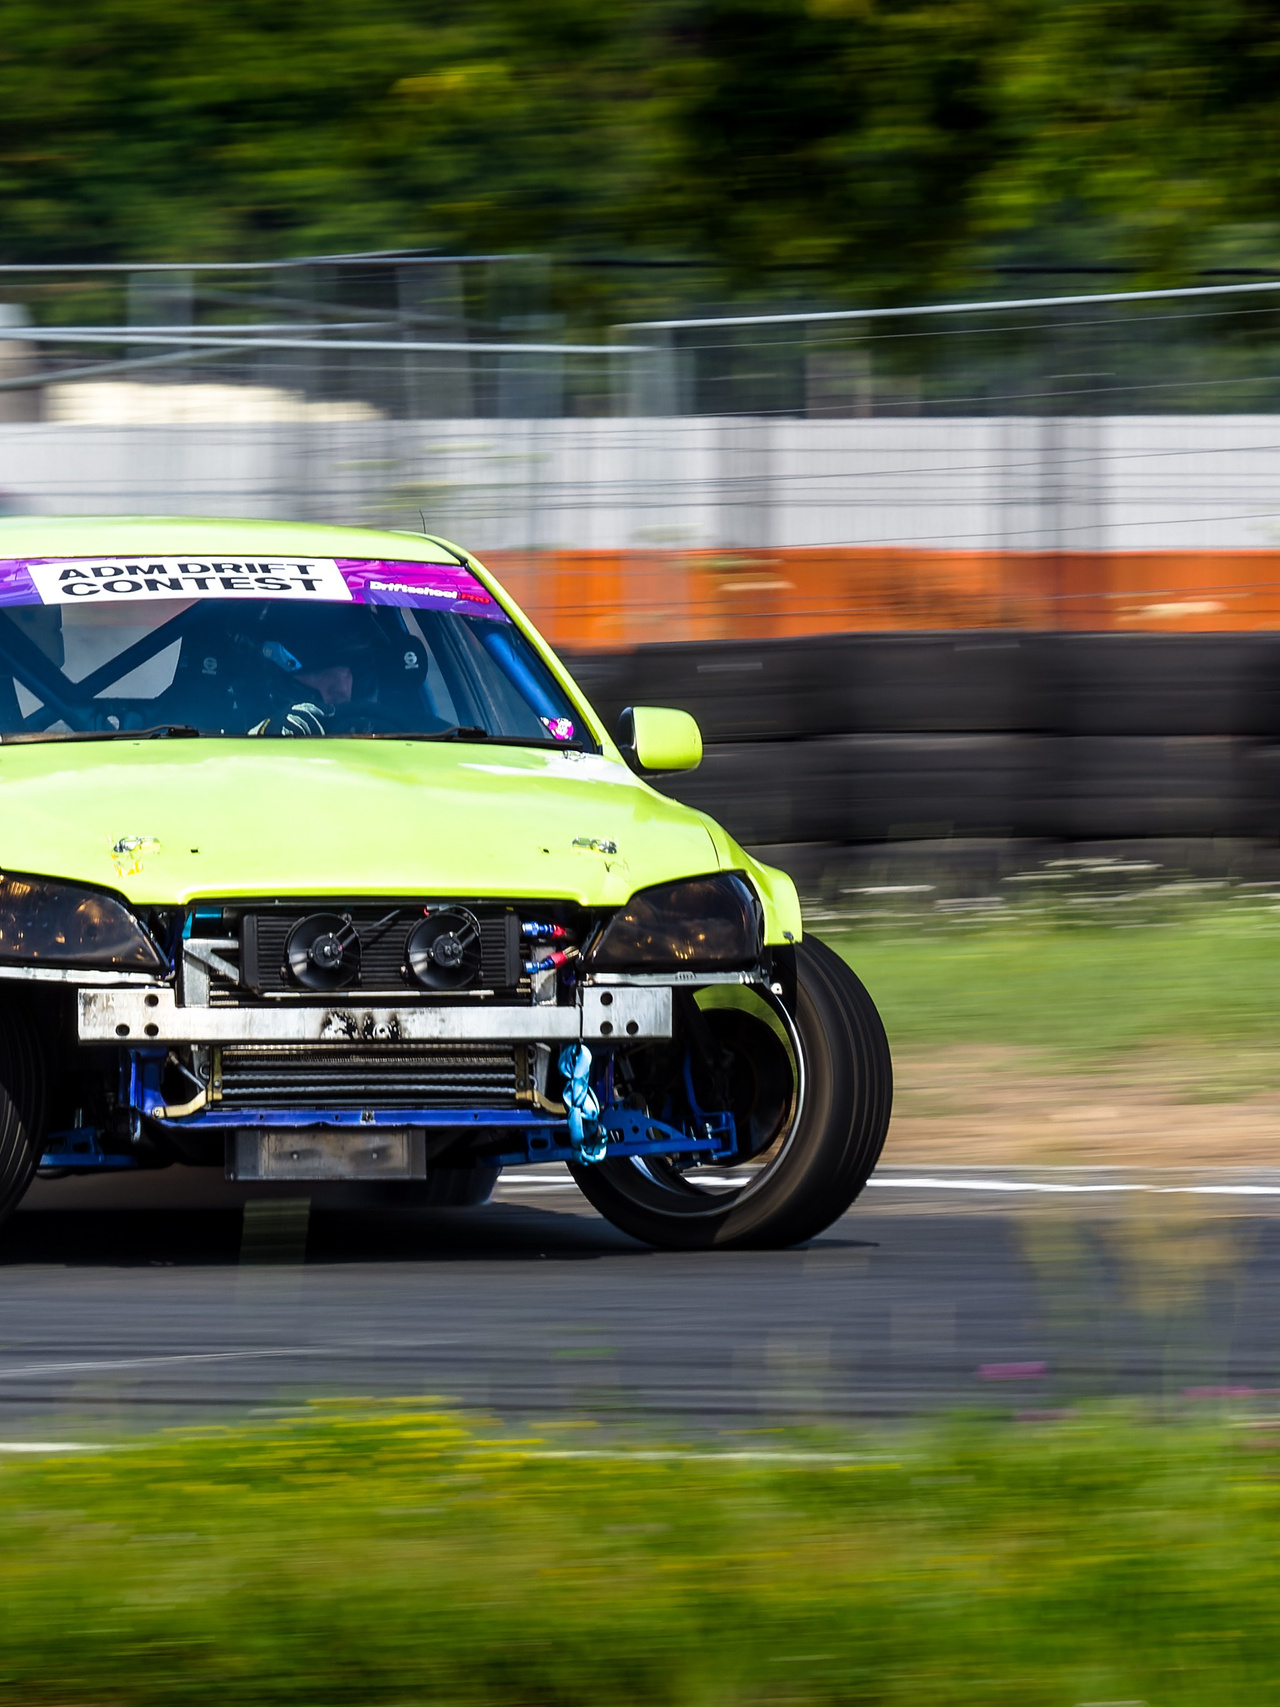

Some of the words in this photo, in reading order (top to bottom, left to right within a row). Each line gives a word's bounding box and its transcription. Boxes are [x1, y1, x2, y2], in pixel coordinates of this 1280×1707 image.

[58, 564, 167, 581] ADM
[177, 562, 315, 575] DRIFT
[61, 576, 323, 596] CONTEST
